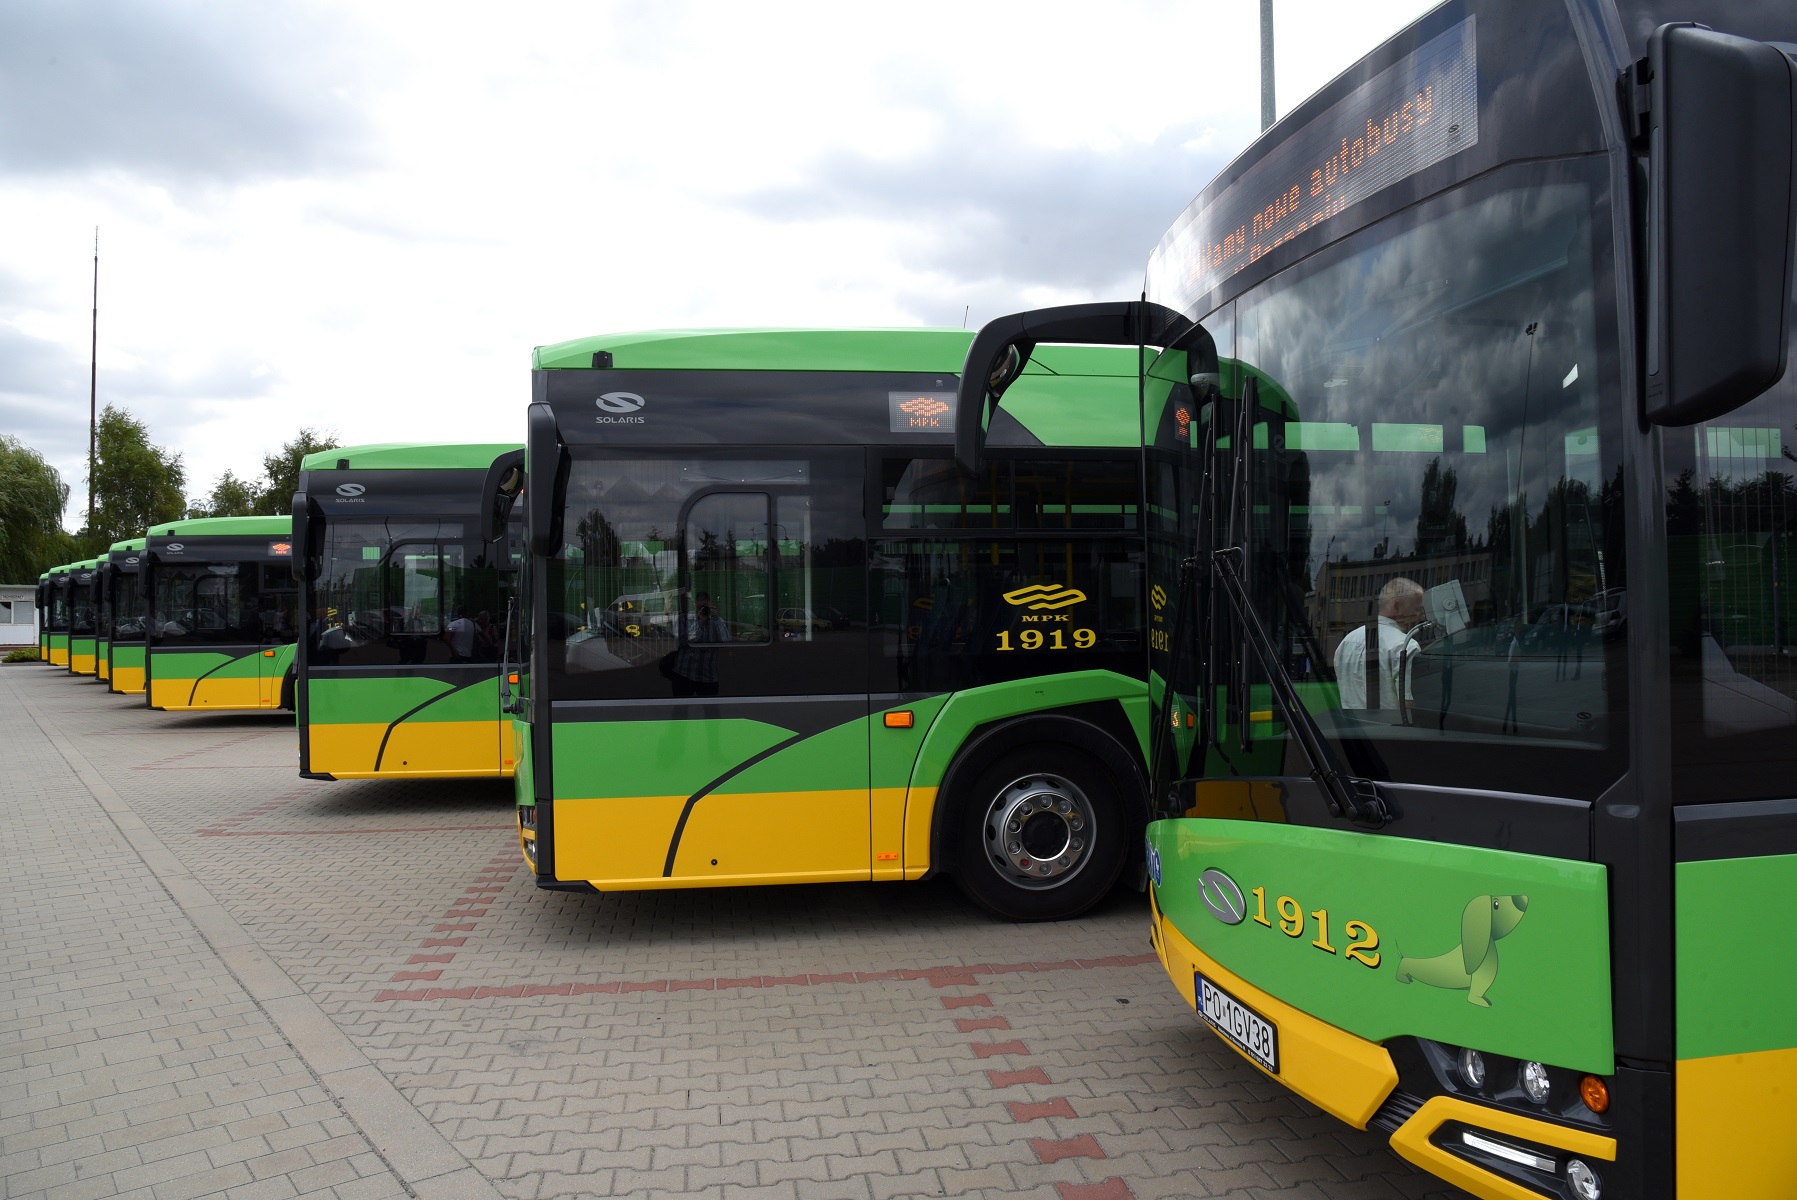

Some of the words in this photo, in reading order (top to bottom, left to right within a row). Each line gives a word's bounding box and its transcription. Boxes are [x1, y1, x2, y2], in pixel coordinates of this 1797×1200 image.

[1253, 184, 1300, 239] nowe
[1310, 86, 1432, 197] autobusy
[595, 416, 645, 424] SOLARIS
[909, 417, 940, 427] MPK
[1021, 614, 1070, 622] MPK
[995, 628, 1097, 651] 1919
[1252, 886, 1382, 970] 1912
